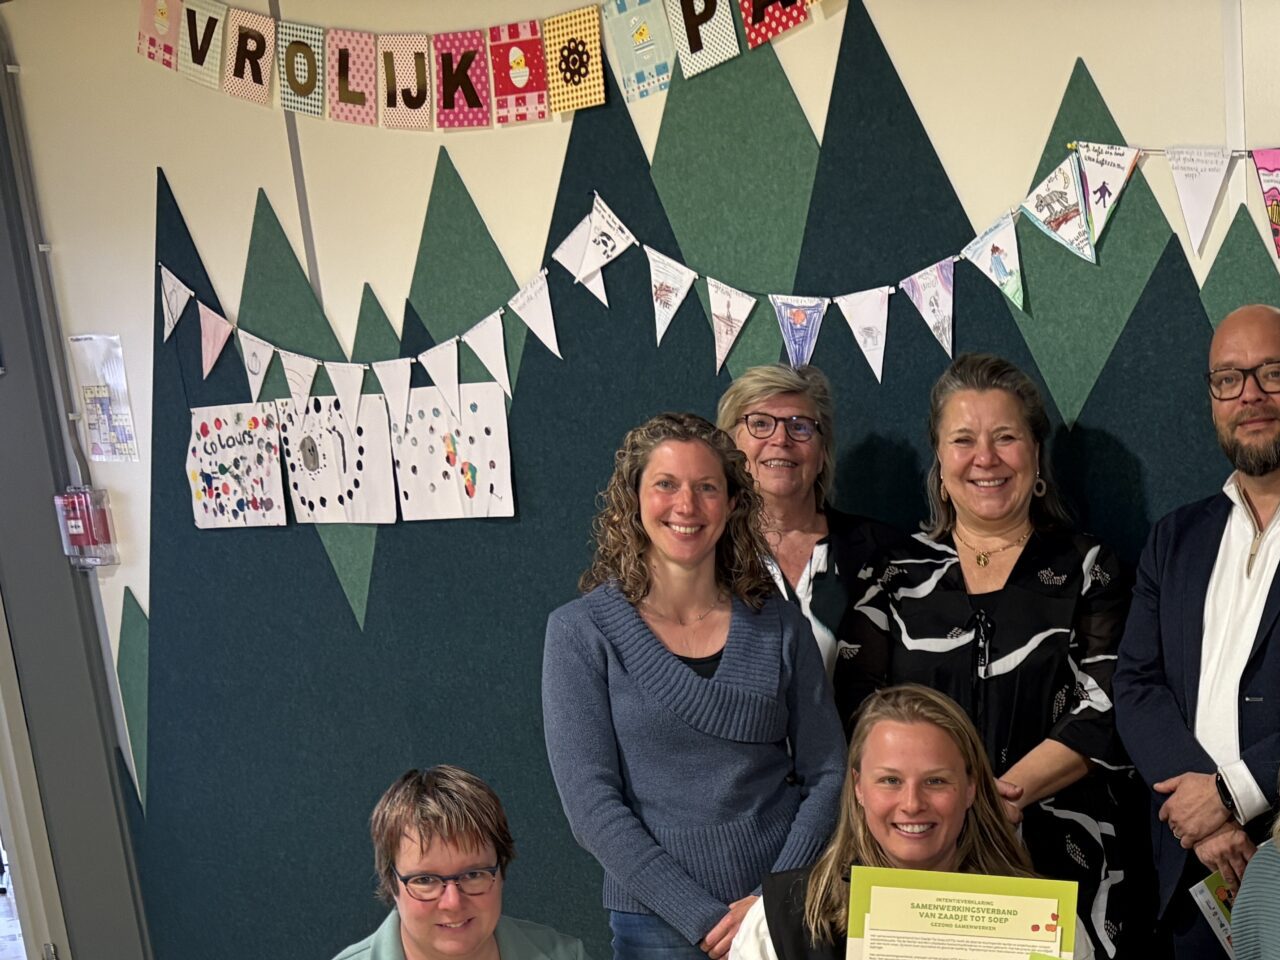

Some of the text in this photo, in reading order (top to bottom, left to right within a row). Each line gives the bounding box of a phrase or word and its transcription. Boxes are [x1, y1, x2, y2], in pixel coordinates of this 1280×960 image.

[186, 8, 484, 110] VROLIJK
[910, 902, 1018, 916] SAMENWERKINGSVERBAND
[919, 911, 1009, 924] VAN ZAADJE TOT SOEP
